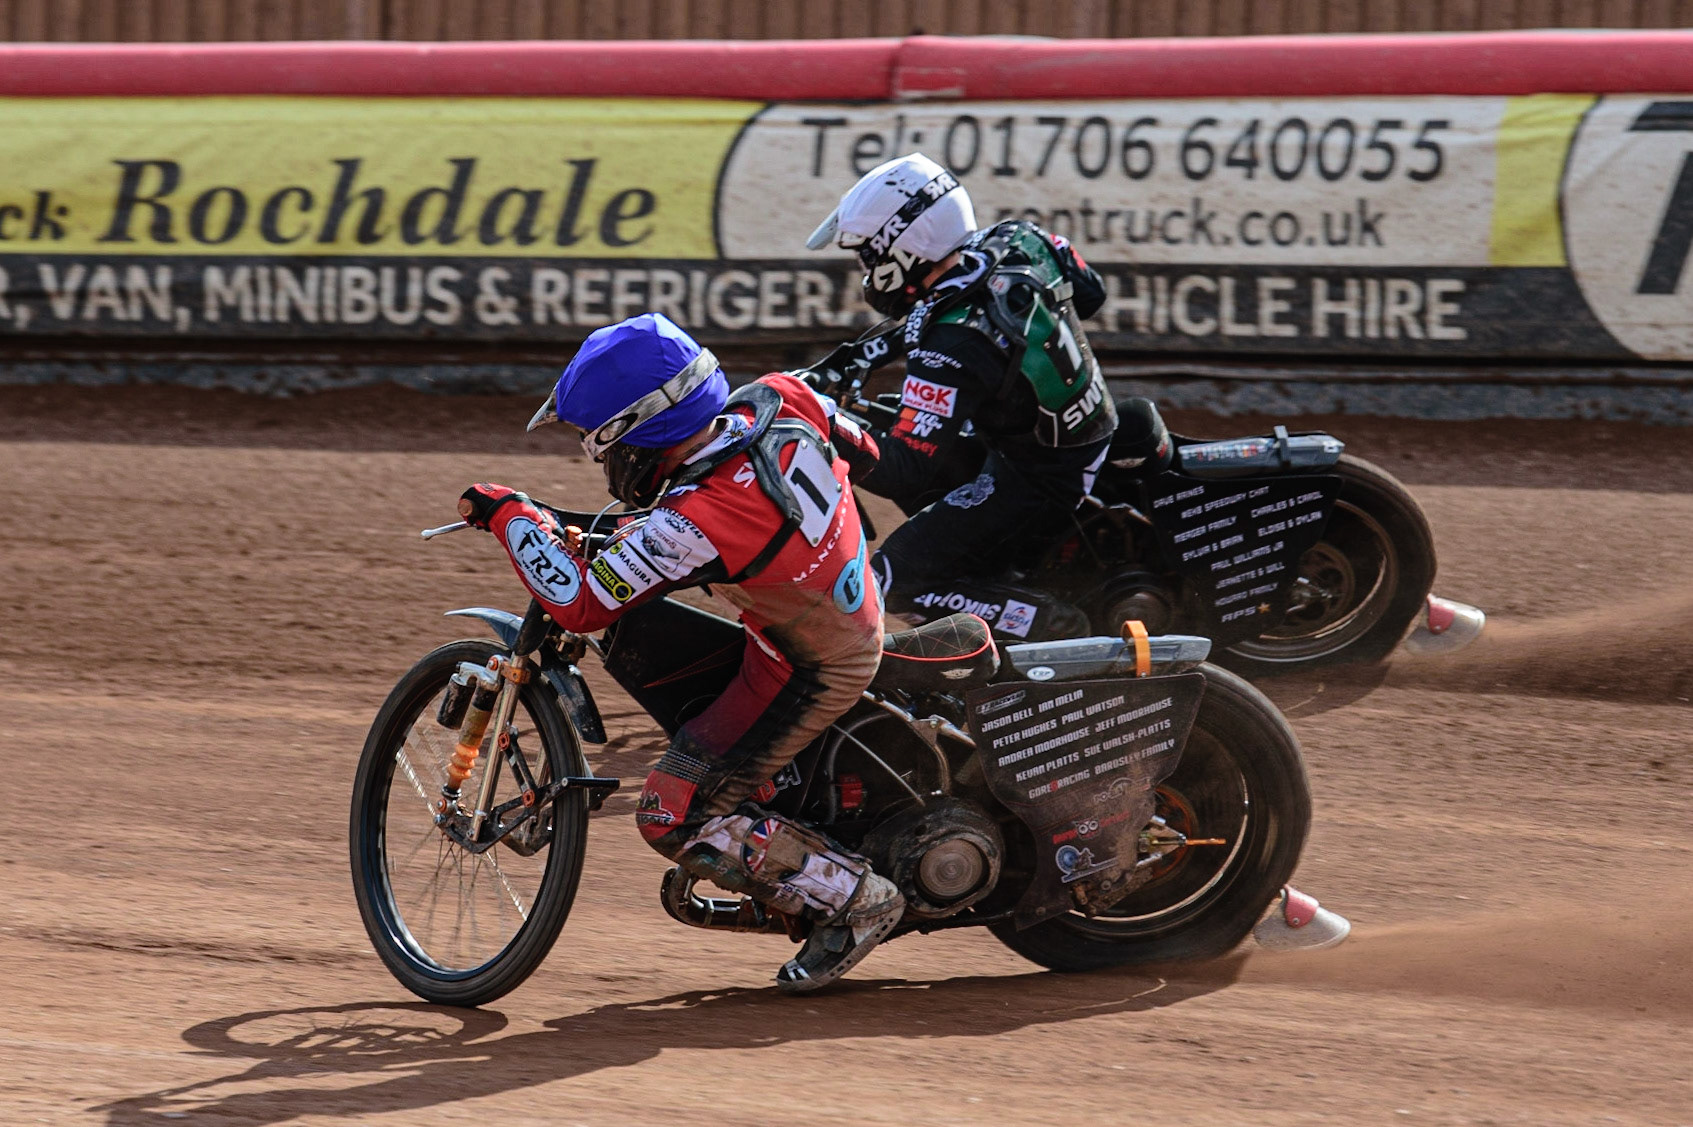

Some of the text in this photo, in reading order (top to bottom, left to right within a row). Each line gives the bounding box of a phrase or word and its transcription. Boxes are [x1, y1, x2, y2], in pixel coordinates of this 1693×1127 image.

[802, 115, 1448, 181] Tel: 01706 640055
[95, 157, 657, 247] Rochdale
[38, 262, 191, 333] VAN,
[203, 264, 463, 327] MINIBUS
[477, 268, 521, 324] &
[1312, 277, 1467, 341] HIRE
[1057, 320, 1084, 371] 1
[904, 378, 953, 407] NGK
[790, 466, 830, 517] 1
[1207, 515, 1238, 532] FAMILY
[517, 529, 571, 587] FRP
[617, 551, 652, 586] MAGURA
[981, 689, 1084, 733] JASON BELL IAN MELIA
[992, 695, 1125, 750] PETER HUGHES PAUL WATSON
[998, 696, 1173, 768] ANDREA MOORHOUSE JEFF MOORHOUSE
[1015, 718, 1171, 783] KEVAN PLATTS SUE WALSH-PLATTS
[1094, 750, 1141, 776] BARDSLEY
[1141, 738, 1176, 760] FAMILY
